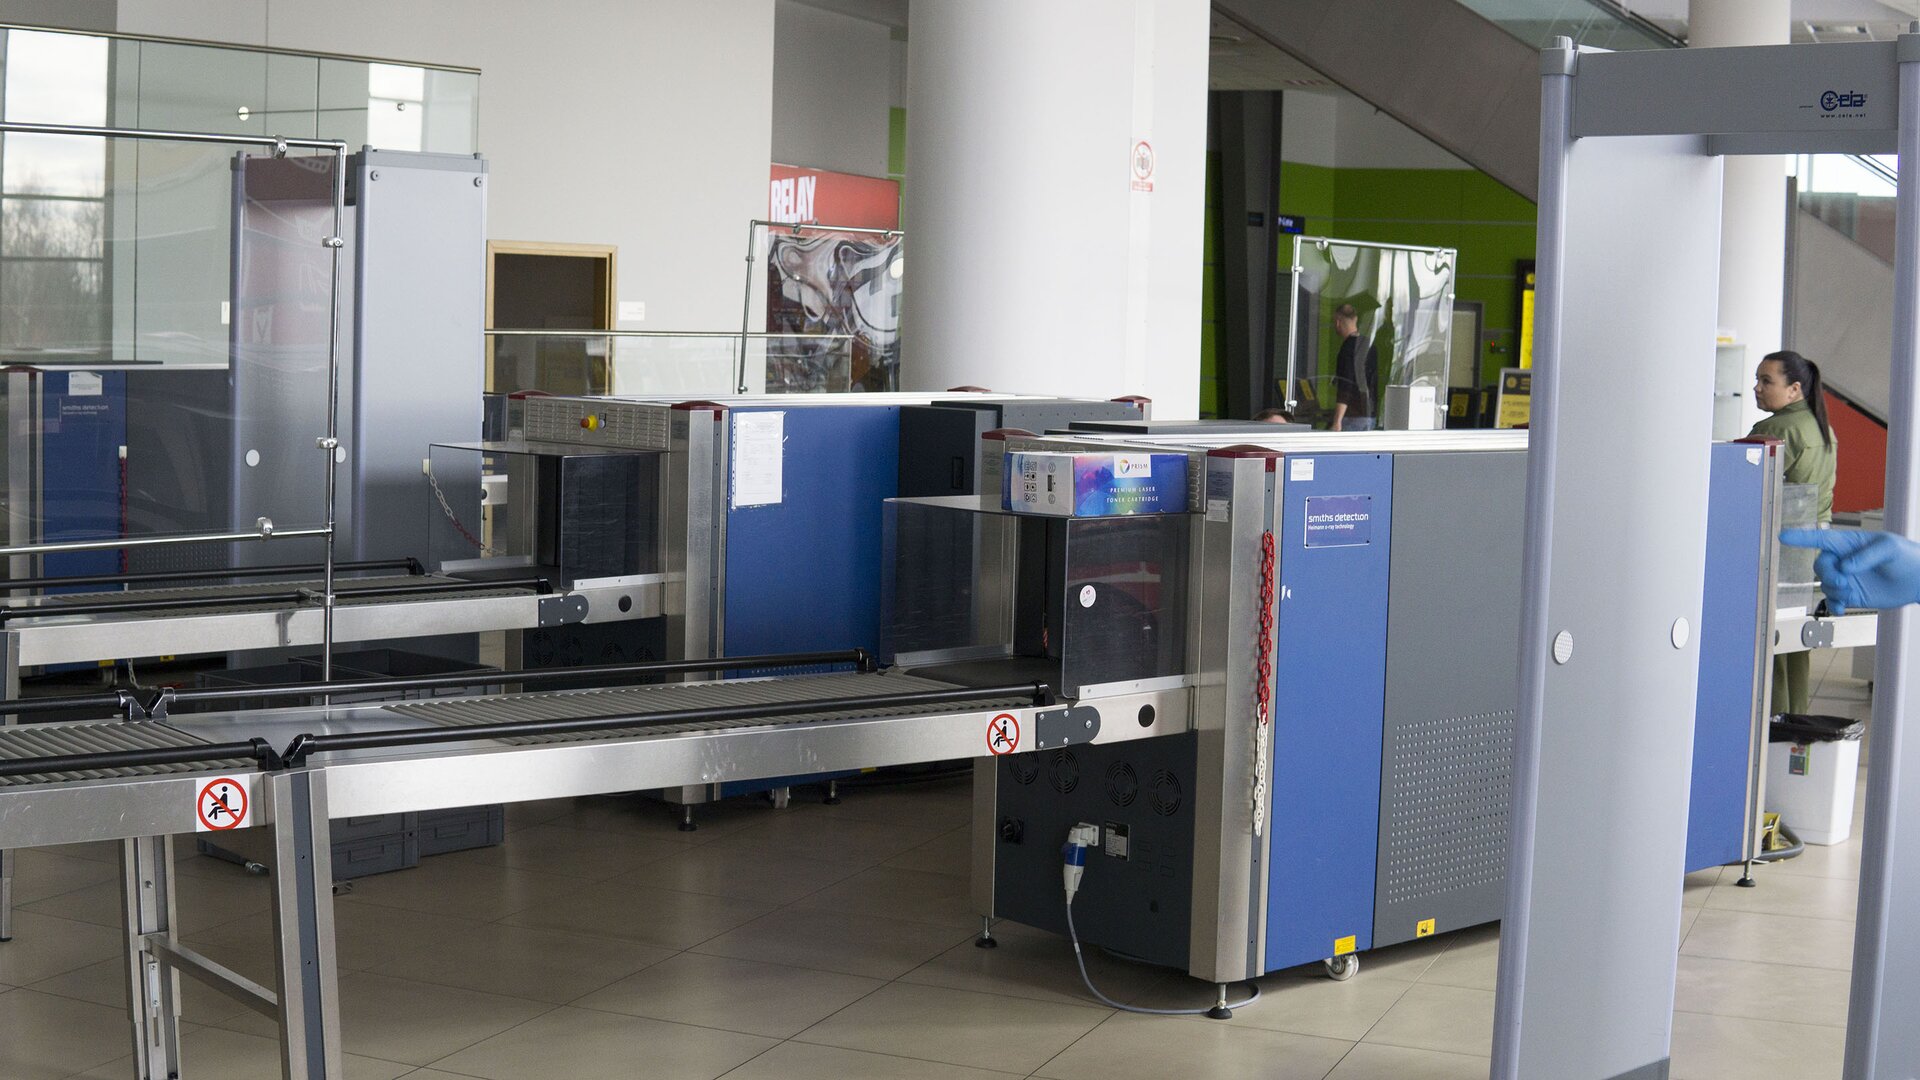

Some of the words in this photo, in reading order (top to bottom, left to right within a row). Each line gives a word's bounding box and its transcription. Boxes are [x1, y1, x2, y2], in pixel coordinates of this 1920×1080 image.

[771, 176, 816, 223] RELAY
[1308, 514, 1333, 523] smiths
[1334, 513, 1368, 521] detection
